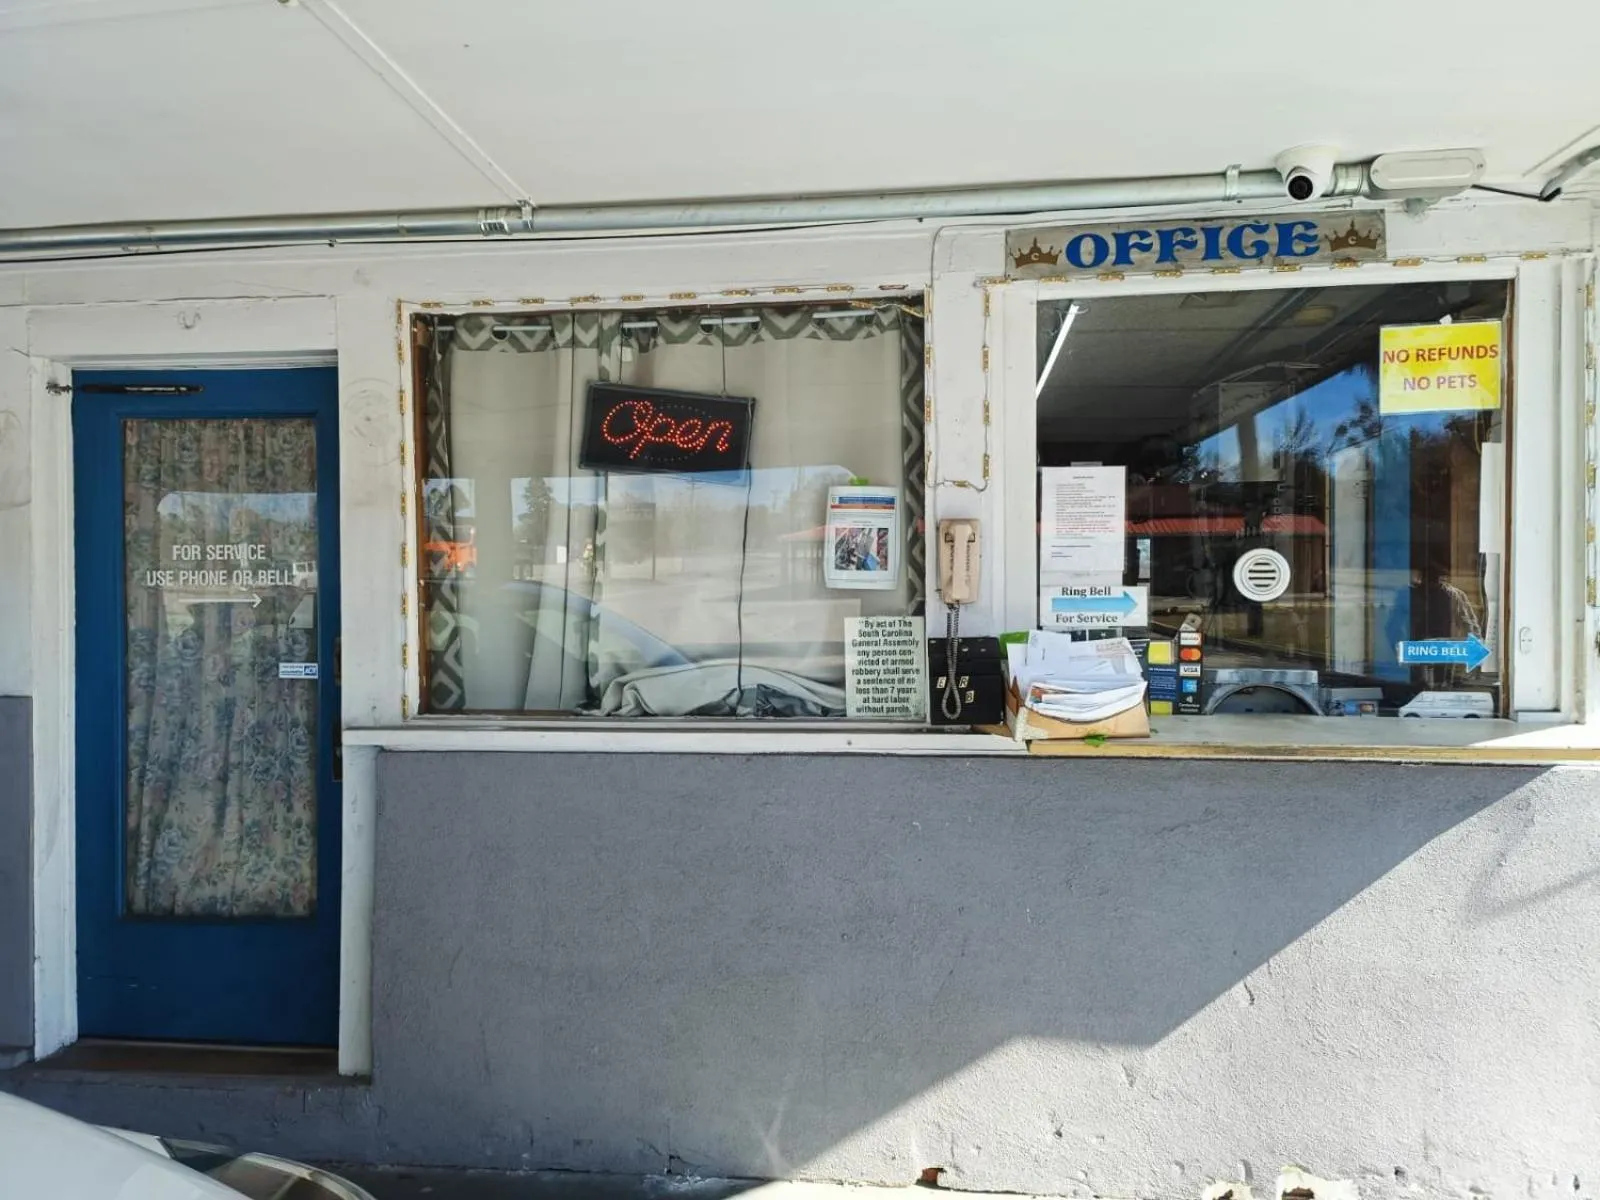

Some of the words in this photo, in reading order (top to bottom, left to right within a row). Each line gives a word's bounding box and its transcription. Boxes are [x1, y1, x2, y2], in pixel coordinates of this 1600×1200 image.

[1065, 220, 1321, 269] OFFICE
[1383, 350, 1410, 364] NO
[1416, 344, 1499, 362] REFUNDS
[1403, 376, 1431, 391] NO
[1437, 374, 1477, 390] PETS
[603, 400, 733, 460] Open
[172, 544, 201, 561] FOR
[206, 544, 266, 561] SERVICE
[146, 570, 174, 586] USE
[180, 570, 228, 586] PHONE
[232, 570, 253, 586] OR
[256, 570, 292, 586] BELL
[1061, 586, 1088, 598] Ring
[1090, 586, 1112, 596] Bell
[1056, 614, 1074, 623] For
[1076, 613, 1118, 623] Service
[898, 620, 912, 628] The
[858, 630, 880, 638] South
[882, 630, 912, 638] Carolina
[852, 638, 881, 648] General
[882, 638, 920, 648] Assembly
[856, 650, 870, 658] any
[872, 650, 896, 658] person
[1408, 646, 1438, 656] RING
[1441, 646, 1468, 656] BELL
[858, 658, 880, 666] victed
[882, 658, 889, 666] of
[890, 658, 914, 666] armed
[852, 668, 881, 677] robbery
[883, 667, 900, 675] shall
[856, 686, 870, 694] less
[872, 686, 888, 694] than
[890, 686, 895, 694] 7
[896, 687, 917, 697] years
[856, 704, 884, 713] without
